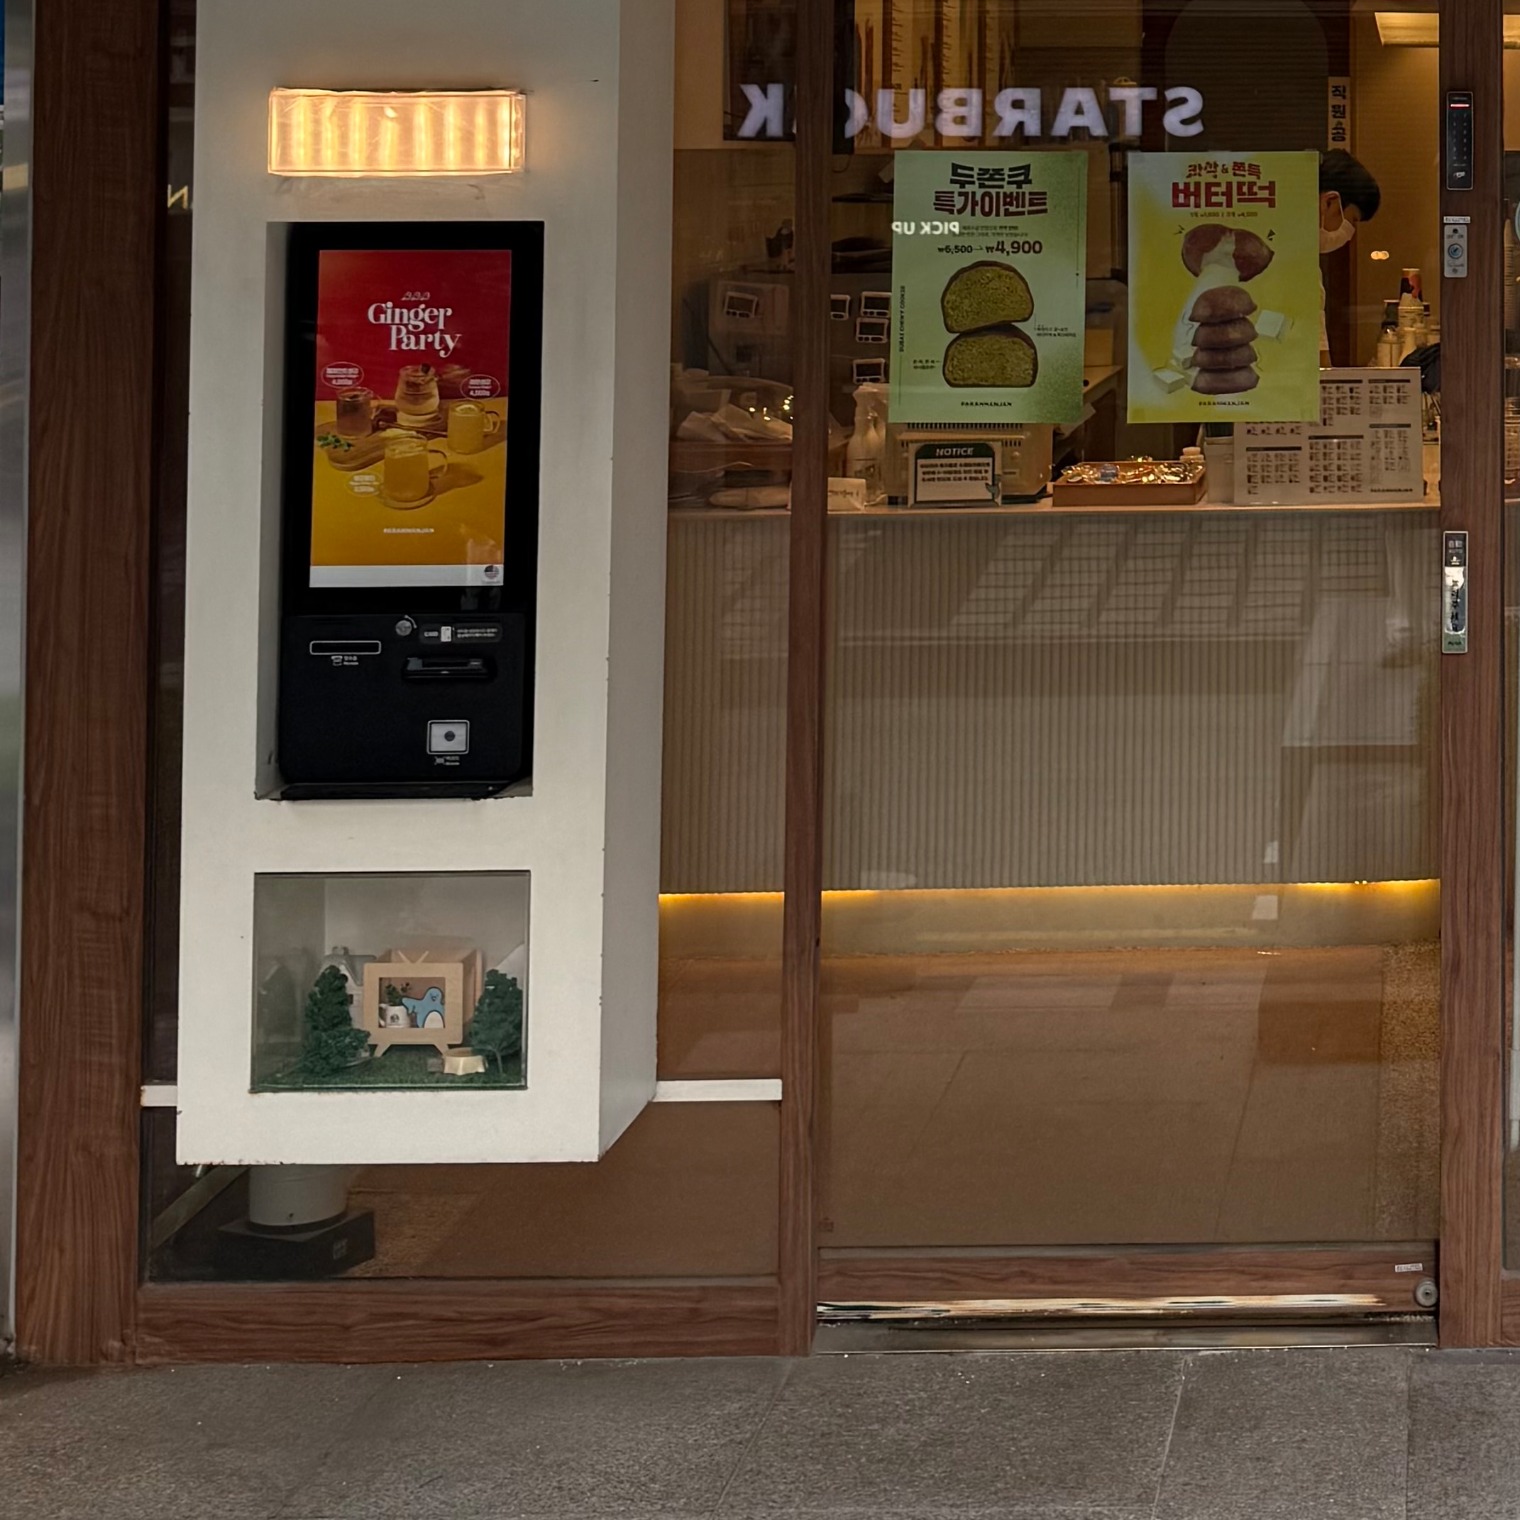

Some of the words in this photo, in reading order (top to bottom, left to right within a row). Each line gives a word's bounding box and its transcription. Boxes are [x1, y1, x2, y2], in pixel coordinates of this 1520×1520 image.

[949, 162, 1033, 190] 두쫀쿠
[933, 190, 1048, 218] 특가이벤트
[1171, 181, 1276, 208] 버터떡
[985, 240, 1043, 257] ₩4,900
[367, 302, 453, 331] Ginger
[388, 325, 462, 358] Party
[935, 447, 974, 457] NOTICE
